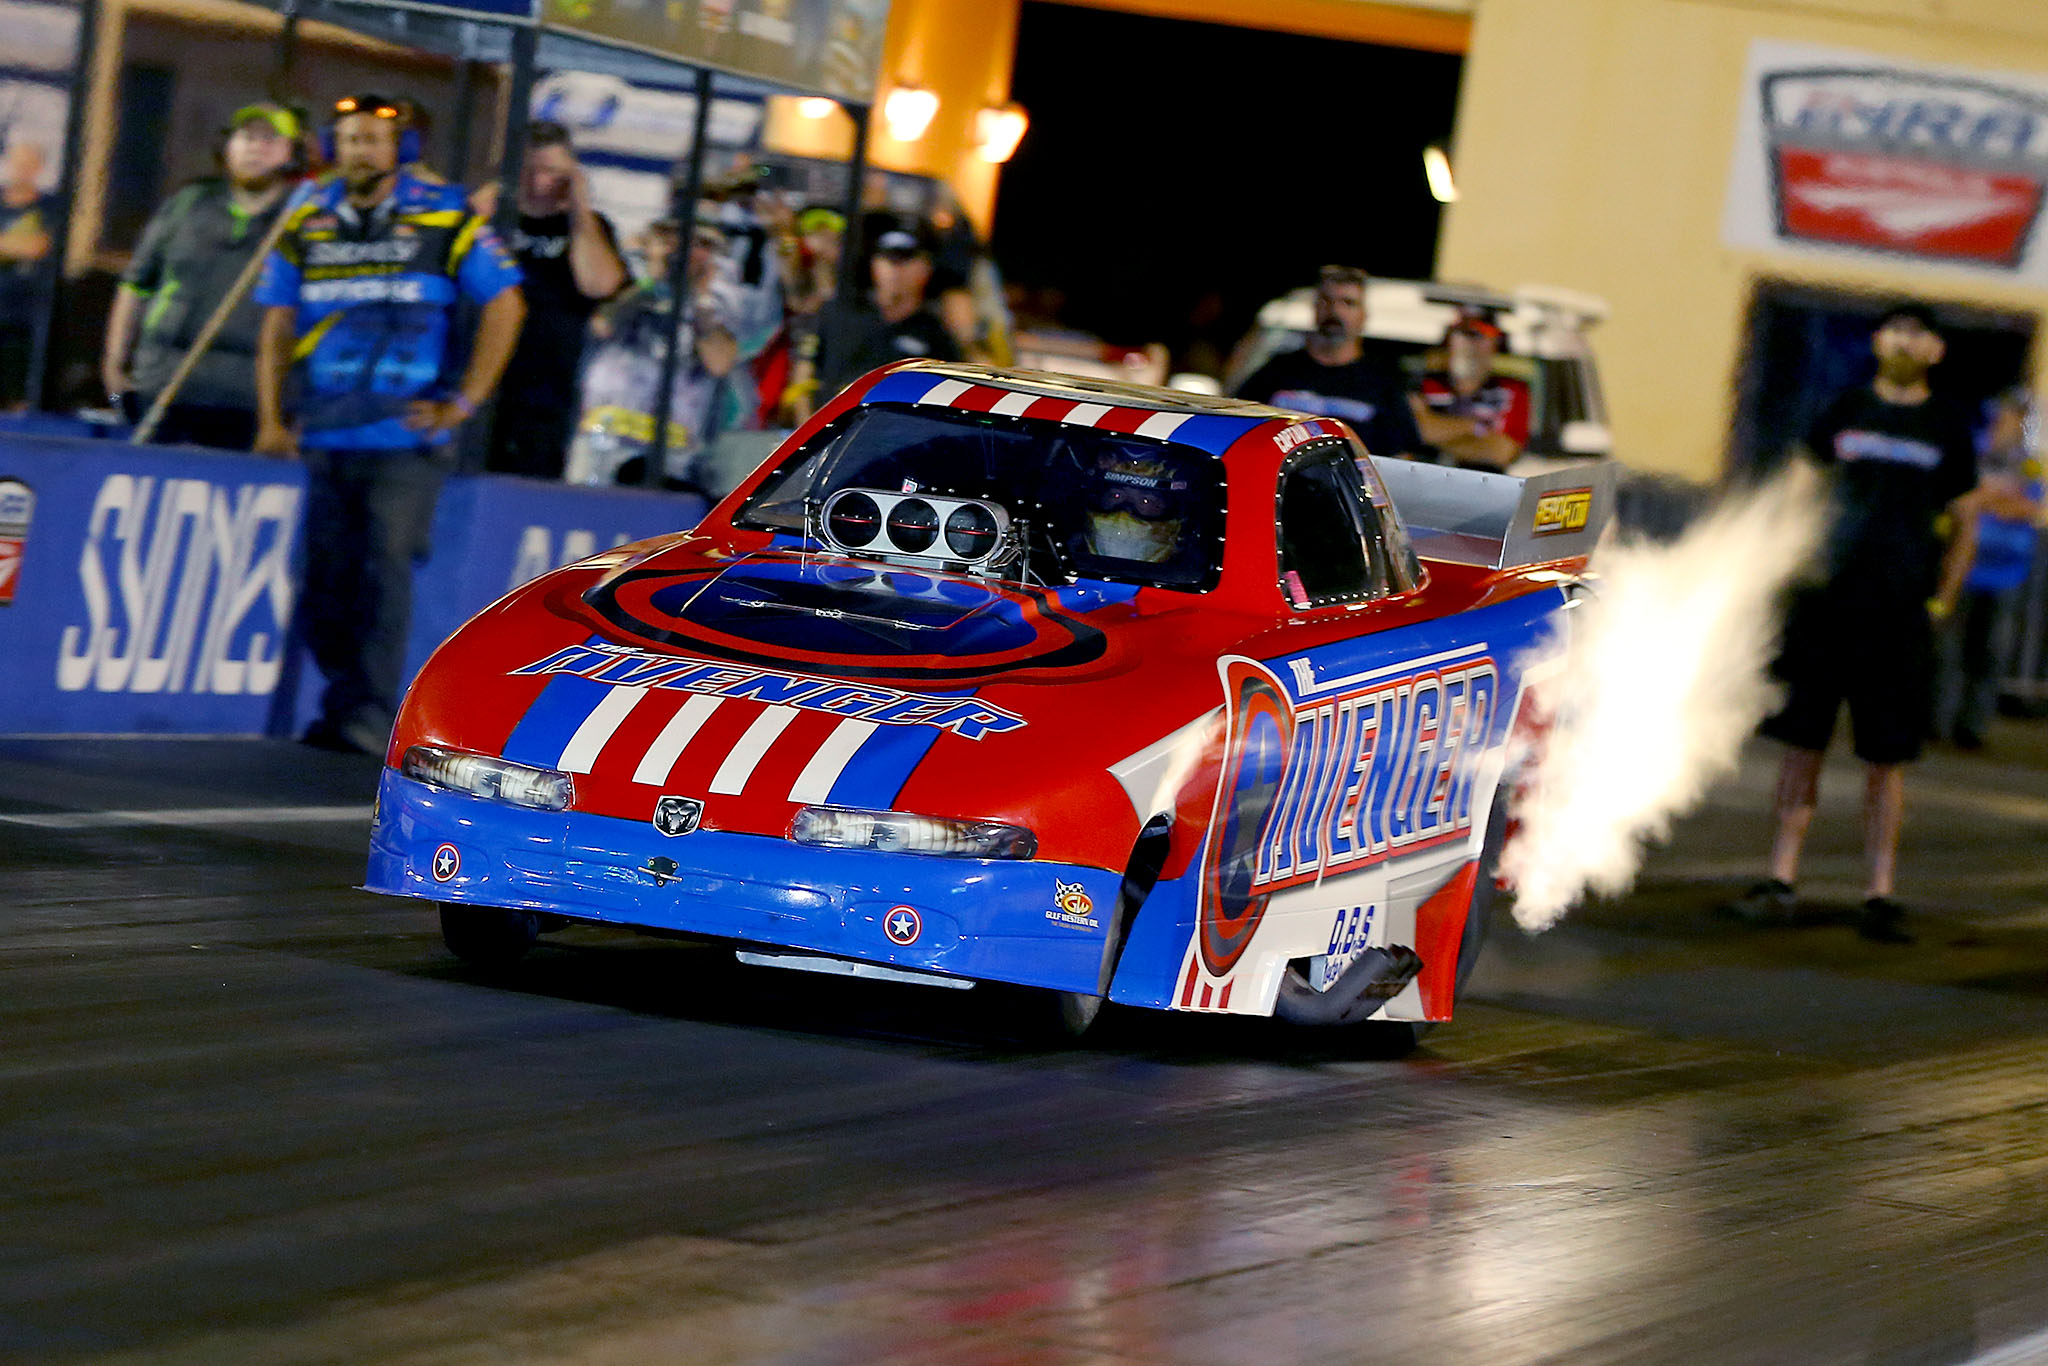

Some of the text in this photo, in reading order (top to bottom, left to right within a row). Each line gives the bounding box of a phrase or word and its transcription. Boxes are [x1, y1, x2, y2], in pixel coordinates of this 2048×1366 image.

[1104, 471, 1158, 488] SIMPSON
[592, 643, 644, 655] THE
[1287, 656, 1318, 697] THE
[507, 645, 1029, 741] AVENGER
[1253, 662, 1497, 887] AVENGER
[1045, 910, 1062, 920] GULF
[1061, 913, 1089, 927] WESTERN
